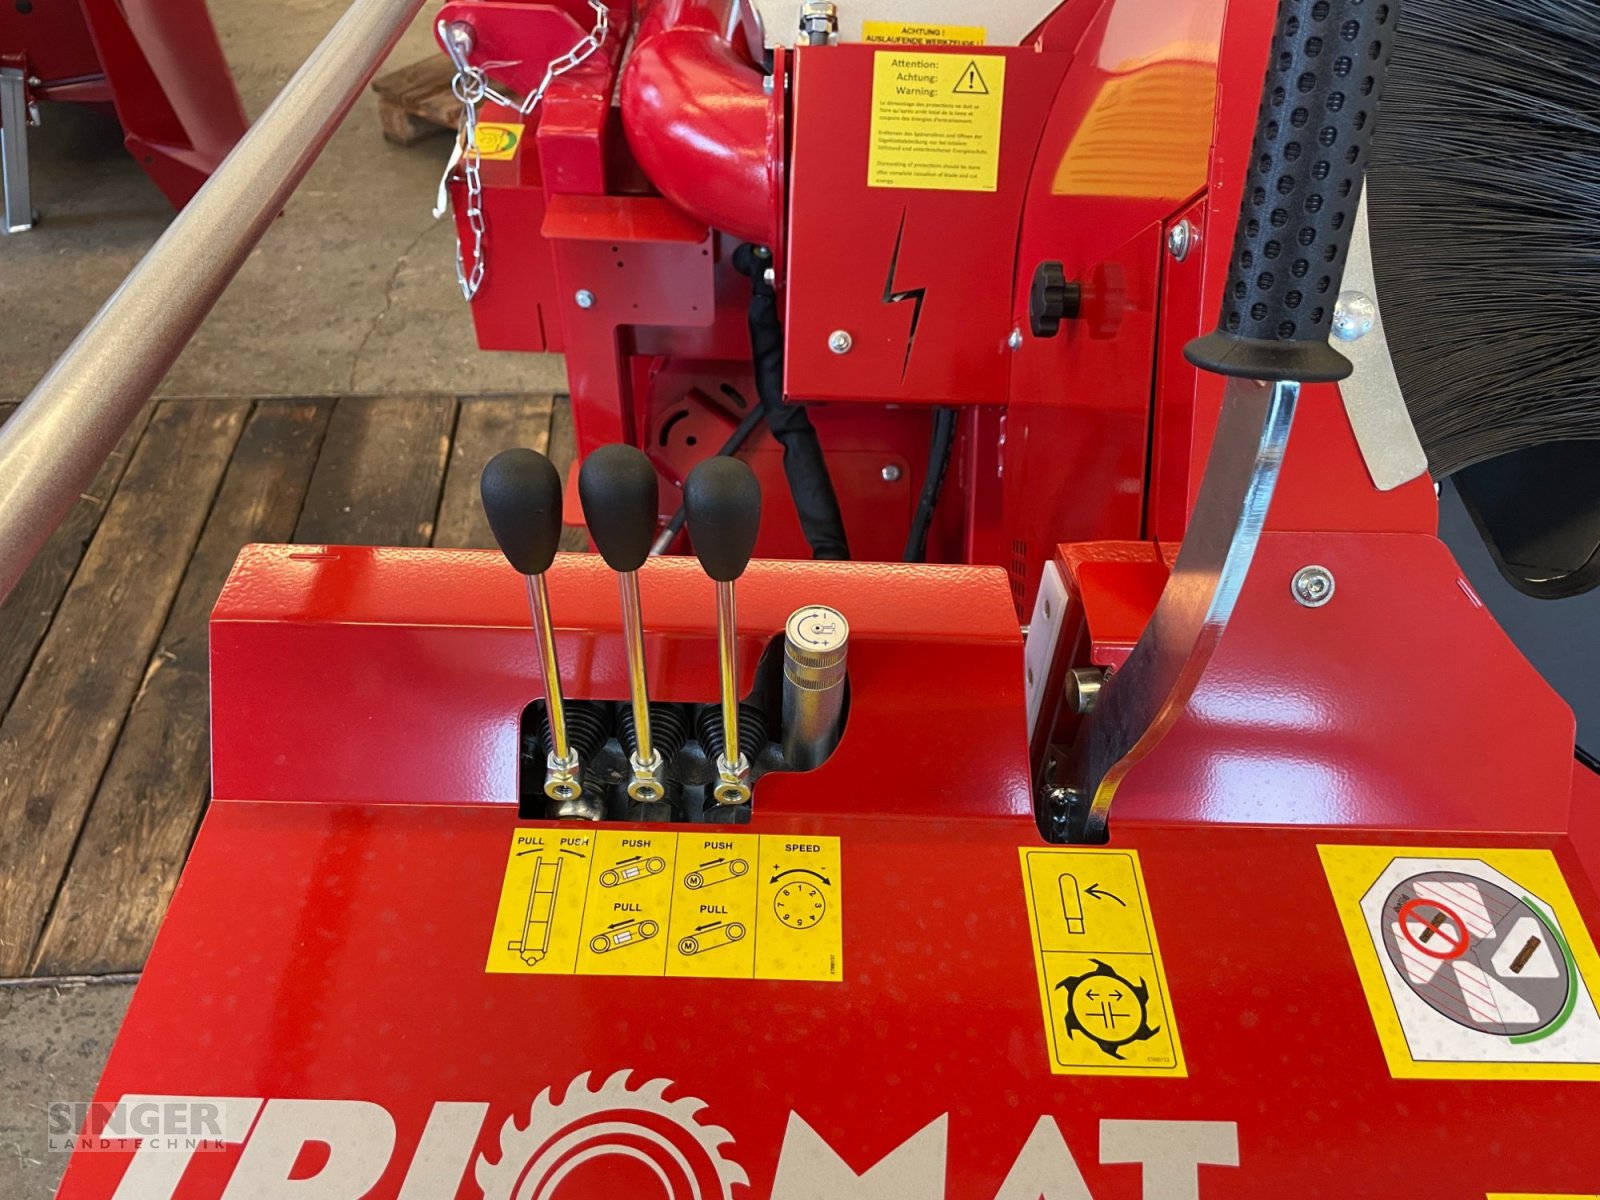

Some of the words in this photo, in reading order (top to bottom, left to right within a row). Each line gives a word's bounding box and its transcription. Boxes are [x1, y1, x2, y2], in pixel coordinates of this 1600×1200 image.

[902, 27, 940, 36] ACHTUNG
[866, 35, 922, 44] AUSLAUFENDE
[891, 59, 939, 69] Attention:
[896, 73, 938, 84] Achtung:
[896, 86, 938, 97] Warning:
[517, 837, 544, 846] PULL
[560, 837, 590, 846] PUSH
[622, 839, 651, 848] PUSH
[704, 841, 733, 850] PUSH
[785, 844, 820, 853] SPEED
[690, 876, 698, 885] M
[798, 884, 802, 892] 1
[614, 903, 642, 912] PULL
[700, 905, 728, 914] PULL
[797, 918, 802, 926] 5
[684, 942, 693, 950] M
